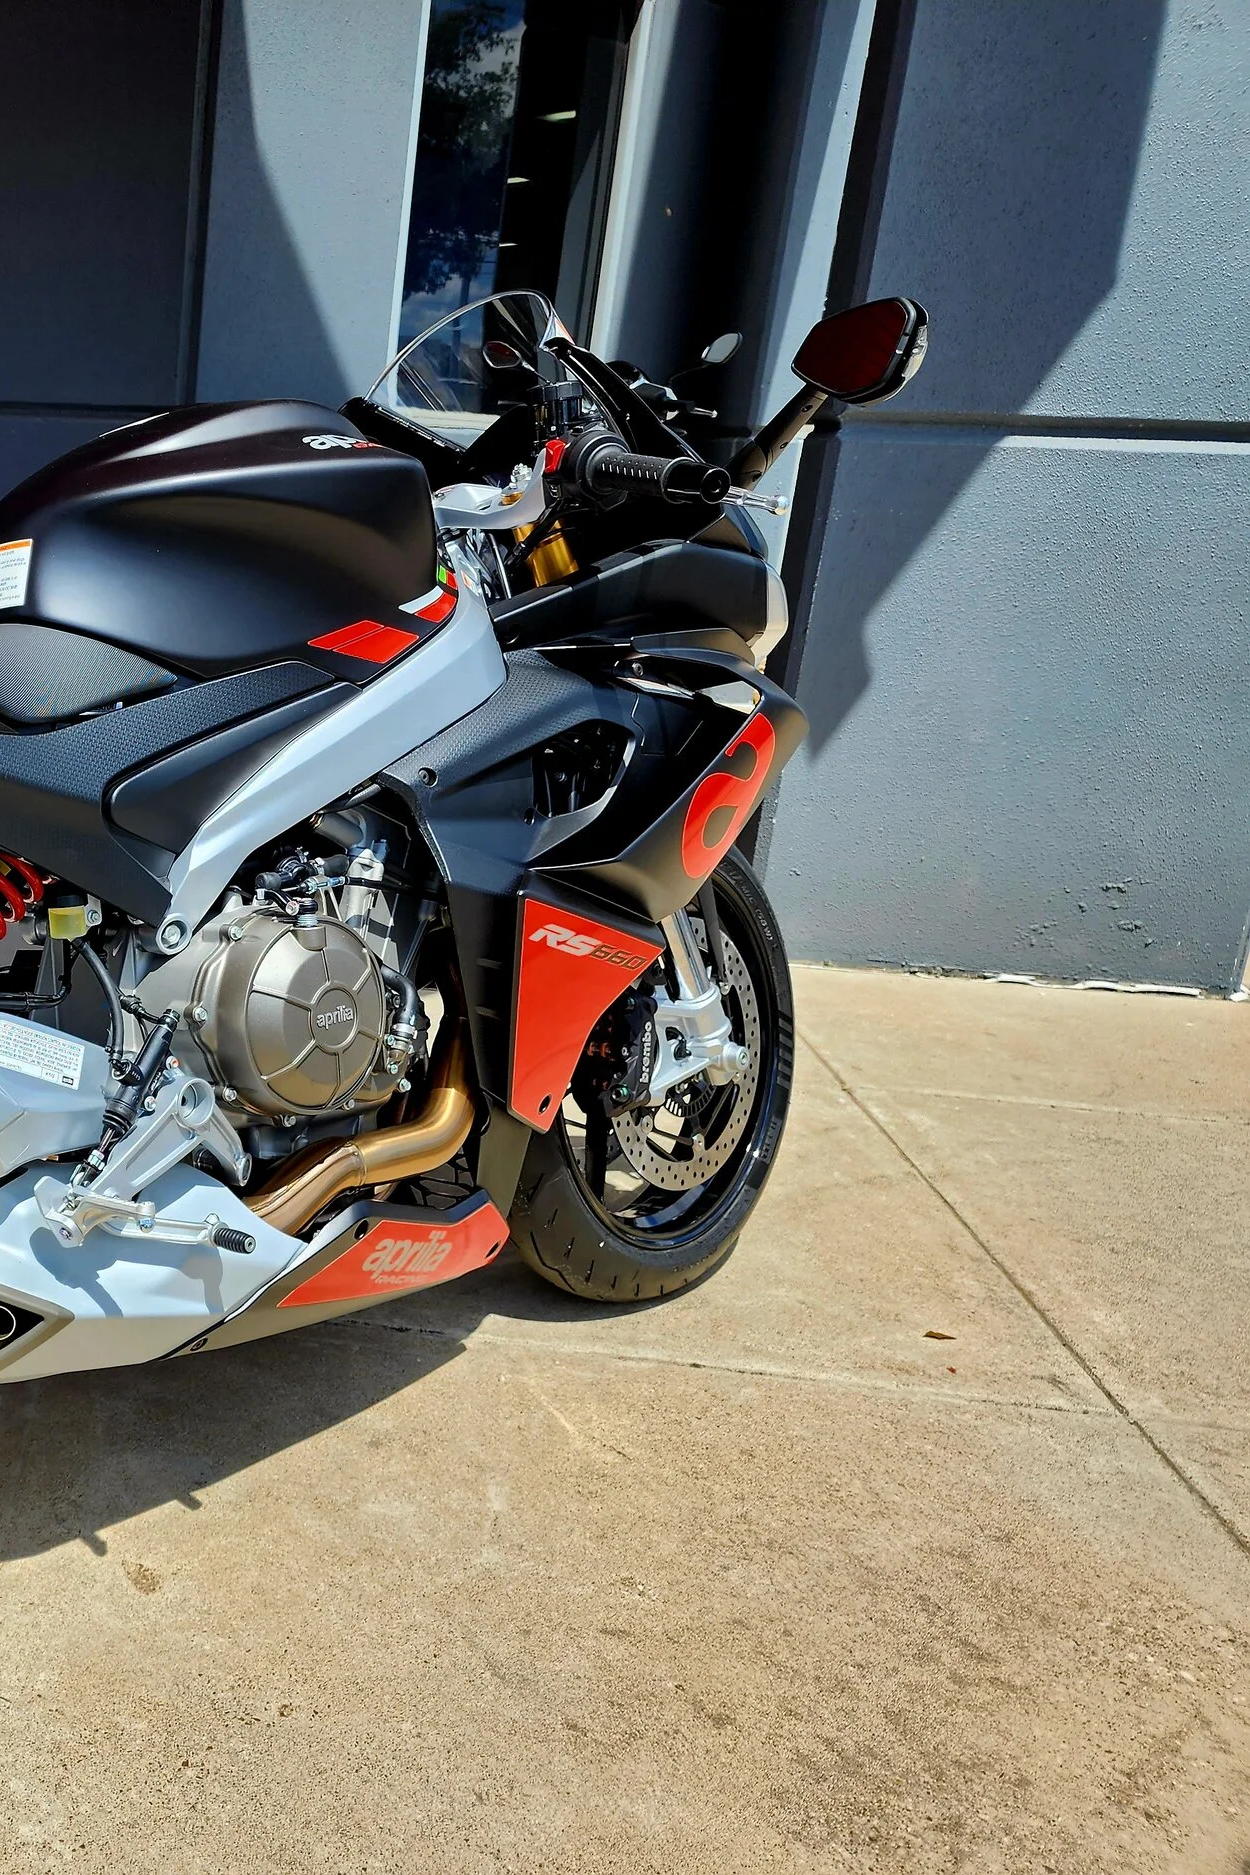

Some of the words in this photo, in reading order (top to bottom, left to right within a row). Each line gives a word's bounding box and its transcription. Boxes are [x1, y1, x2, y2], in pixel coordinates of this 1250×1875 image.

[316, 1005, 354, 1030] aprilia
[639, 1020, 652, 1083] brembo
[362, 1230, 453, 1280] aprilia
